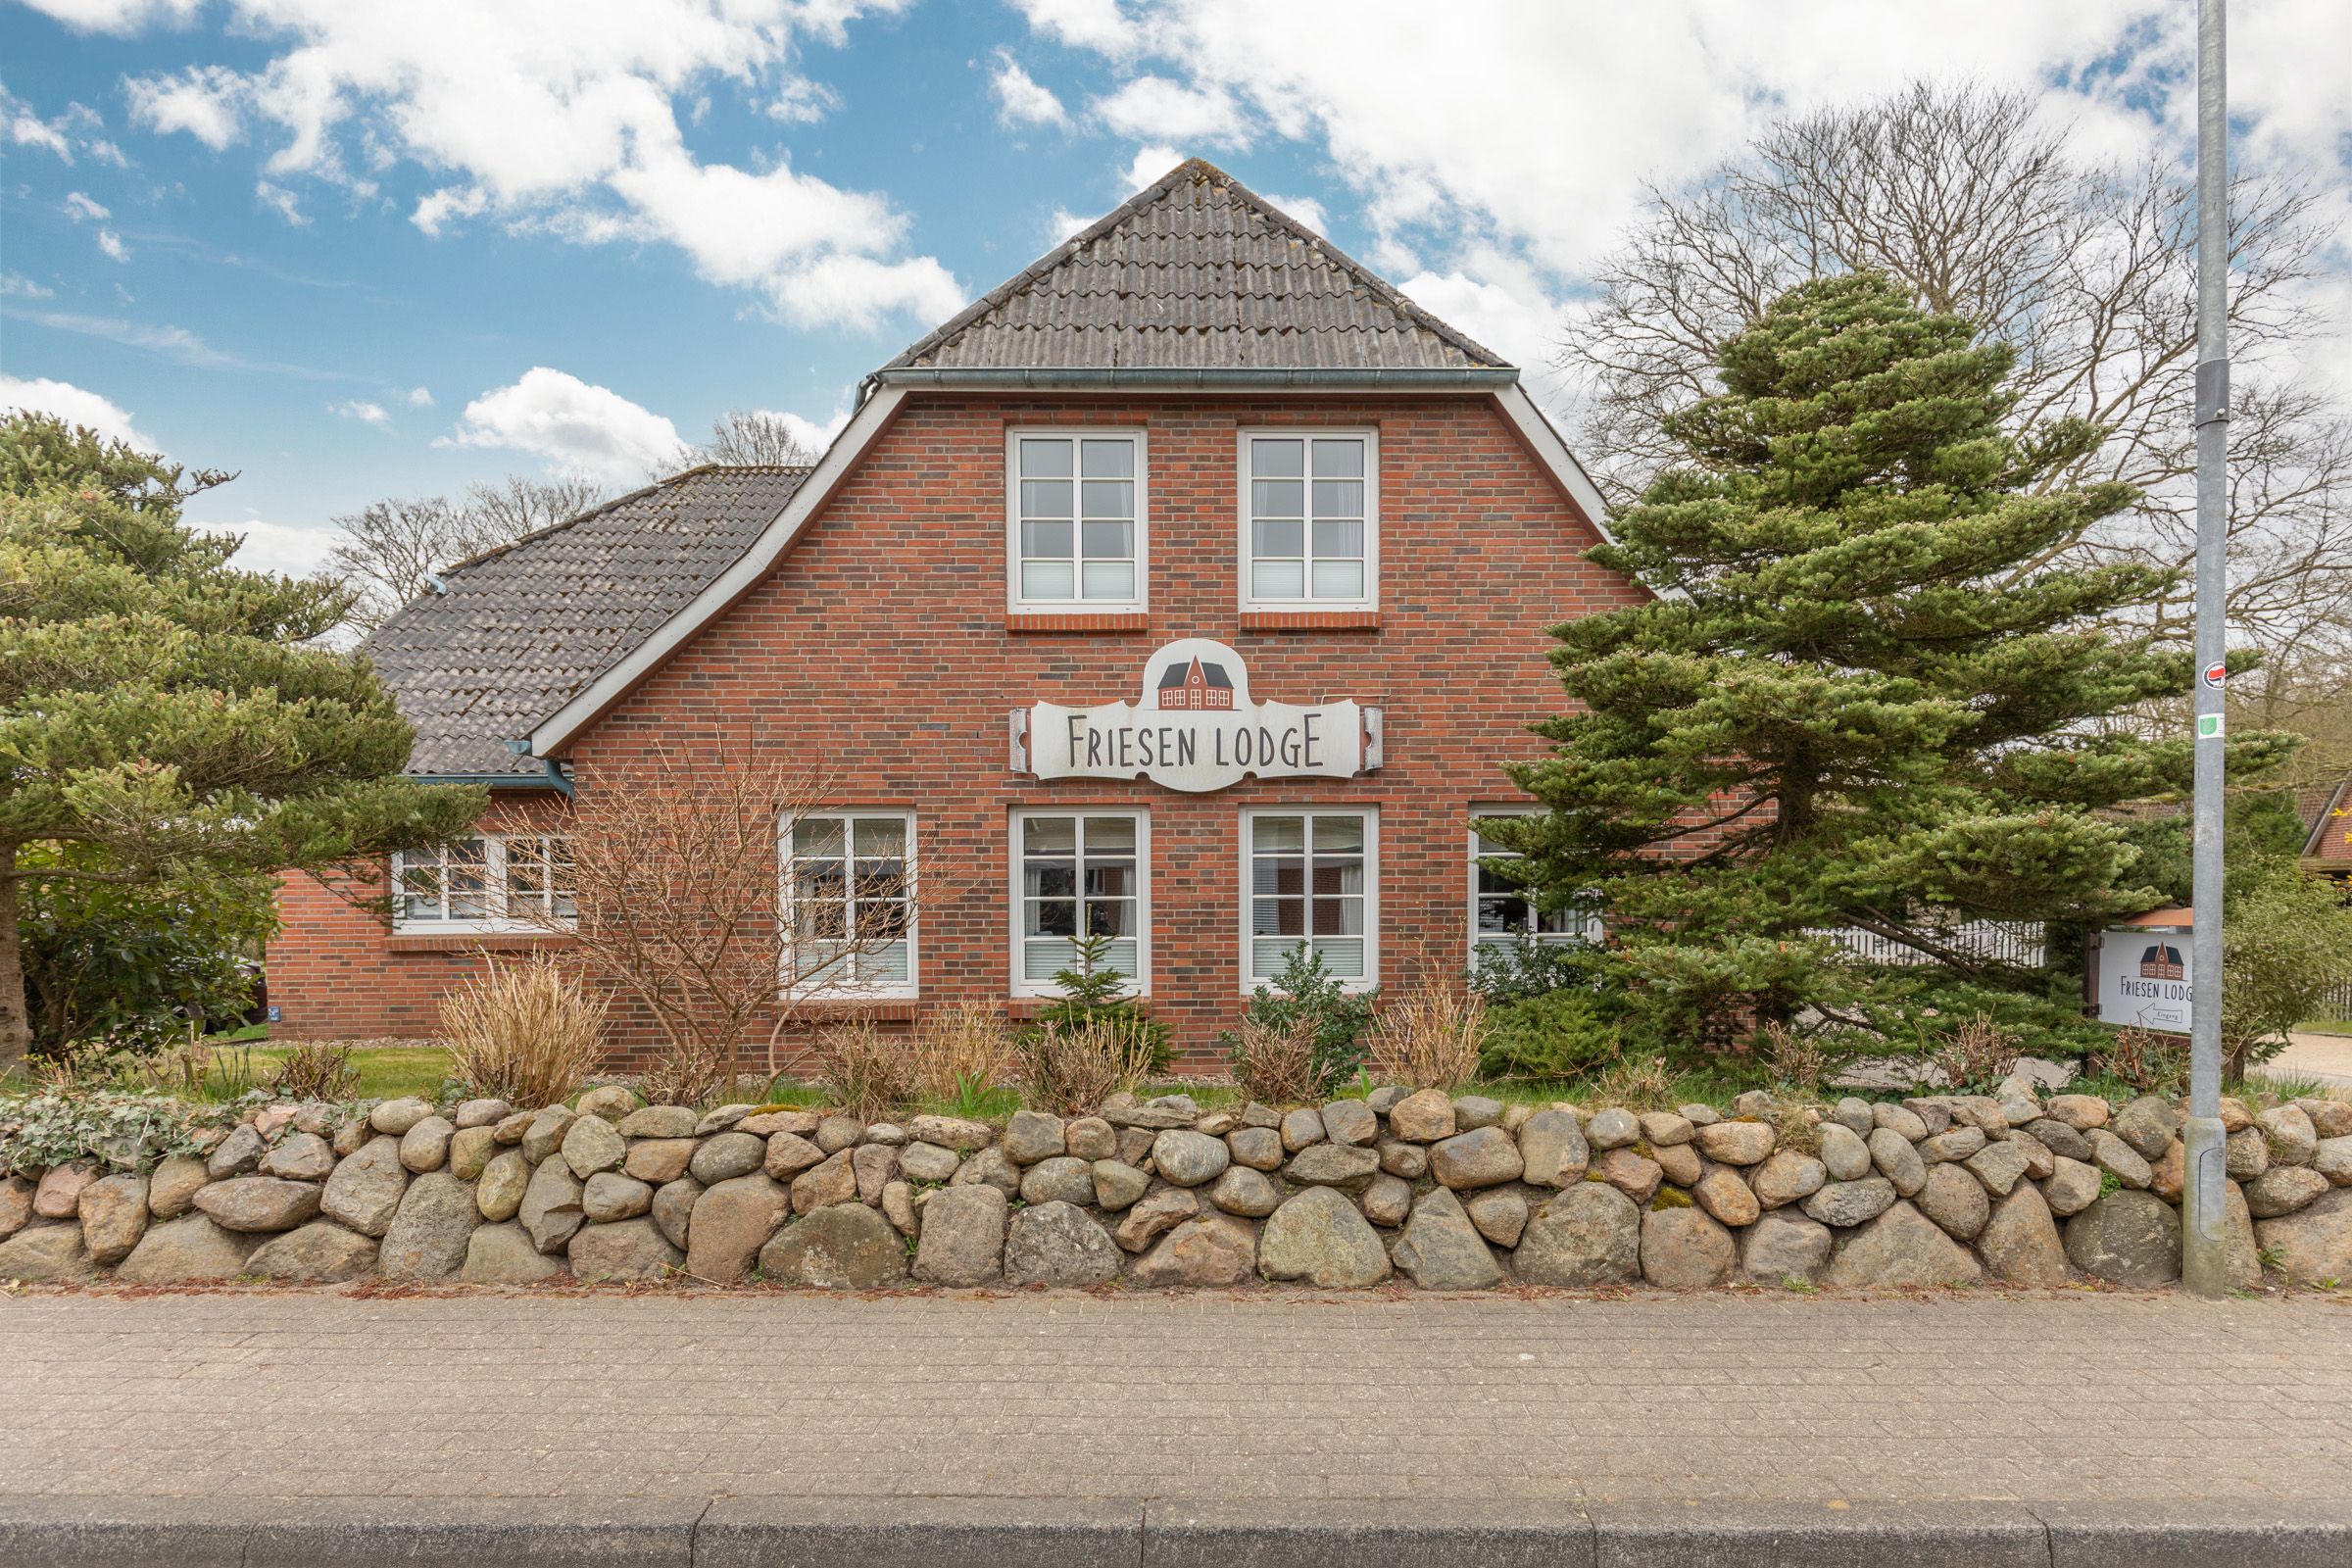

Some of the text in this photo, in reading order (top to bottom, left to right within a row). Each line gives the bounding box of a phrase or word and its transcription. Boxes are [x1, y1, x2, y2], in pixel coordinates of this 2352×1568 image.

[1067, 713, 1324, 768] FRIESEN LODGE
[2120, 975, 2193, 1003] FRIESEN LODG
[2157, 1010, 2179, 1020] Eingang
